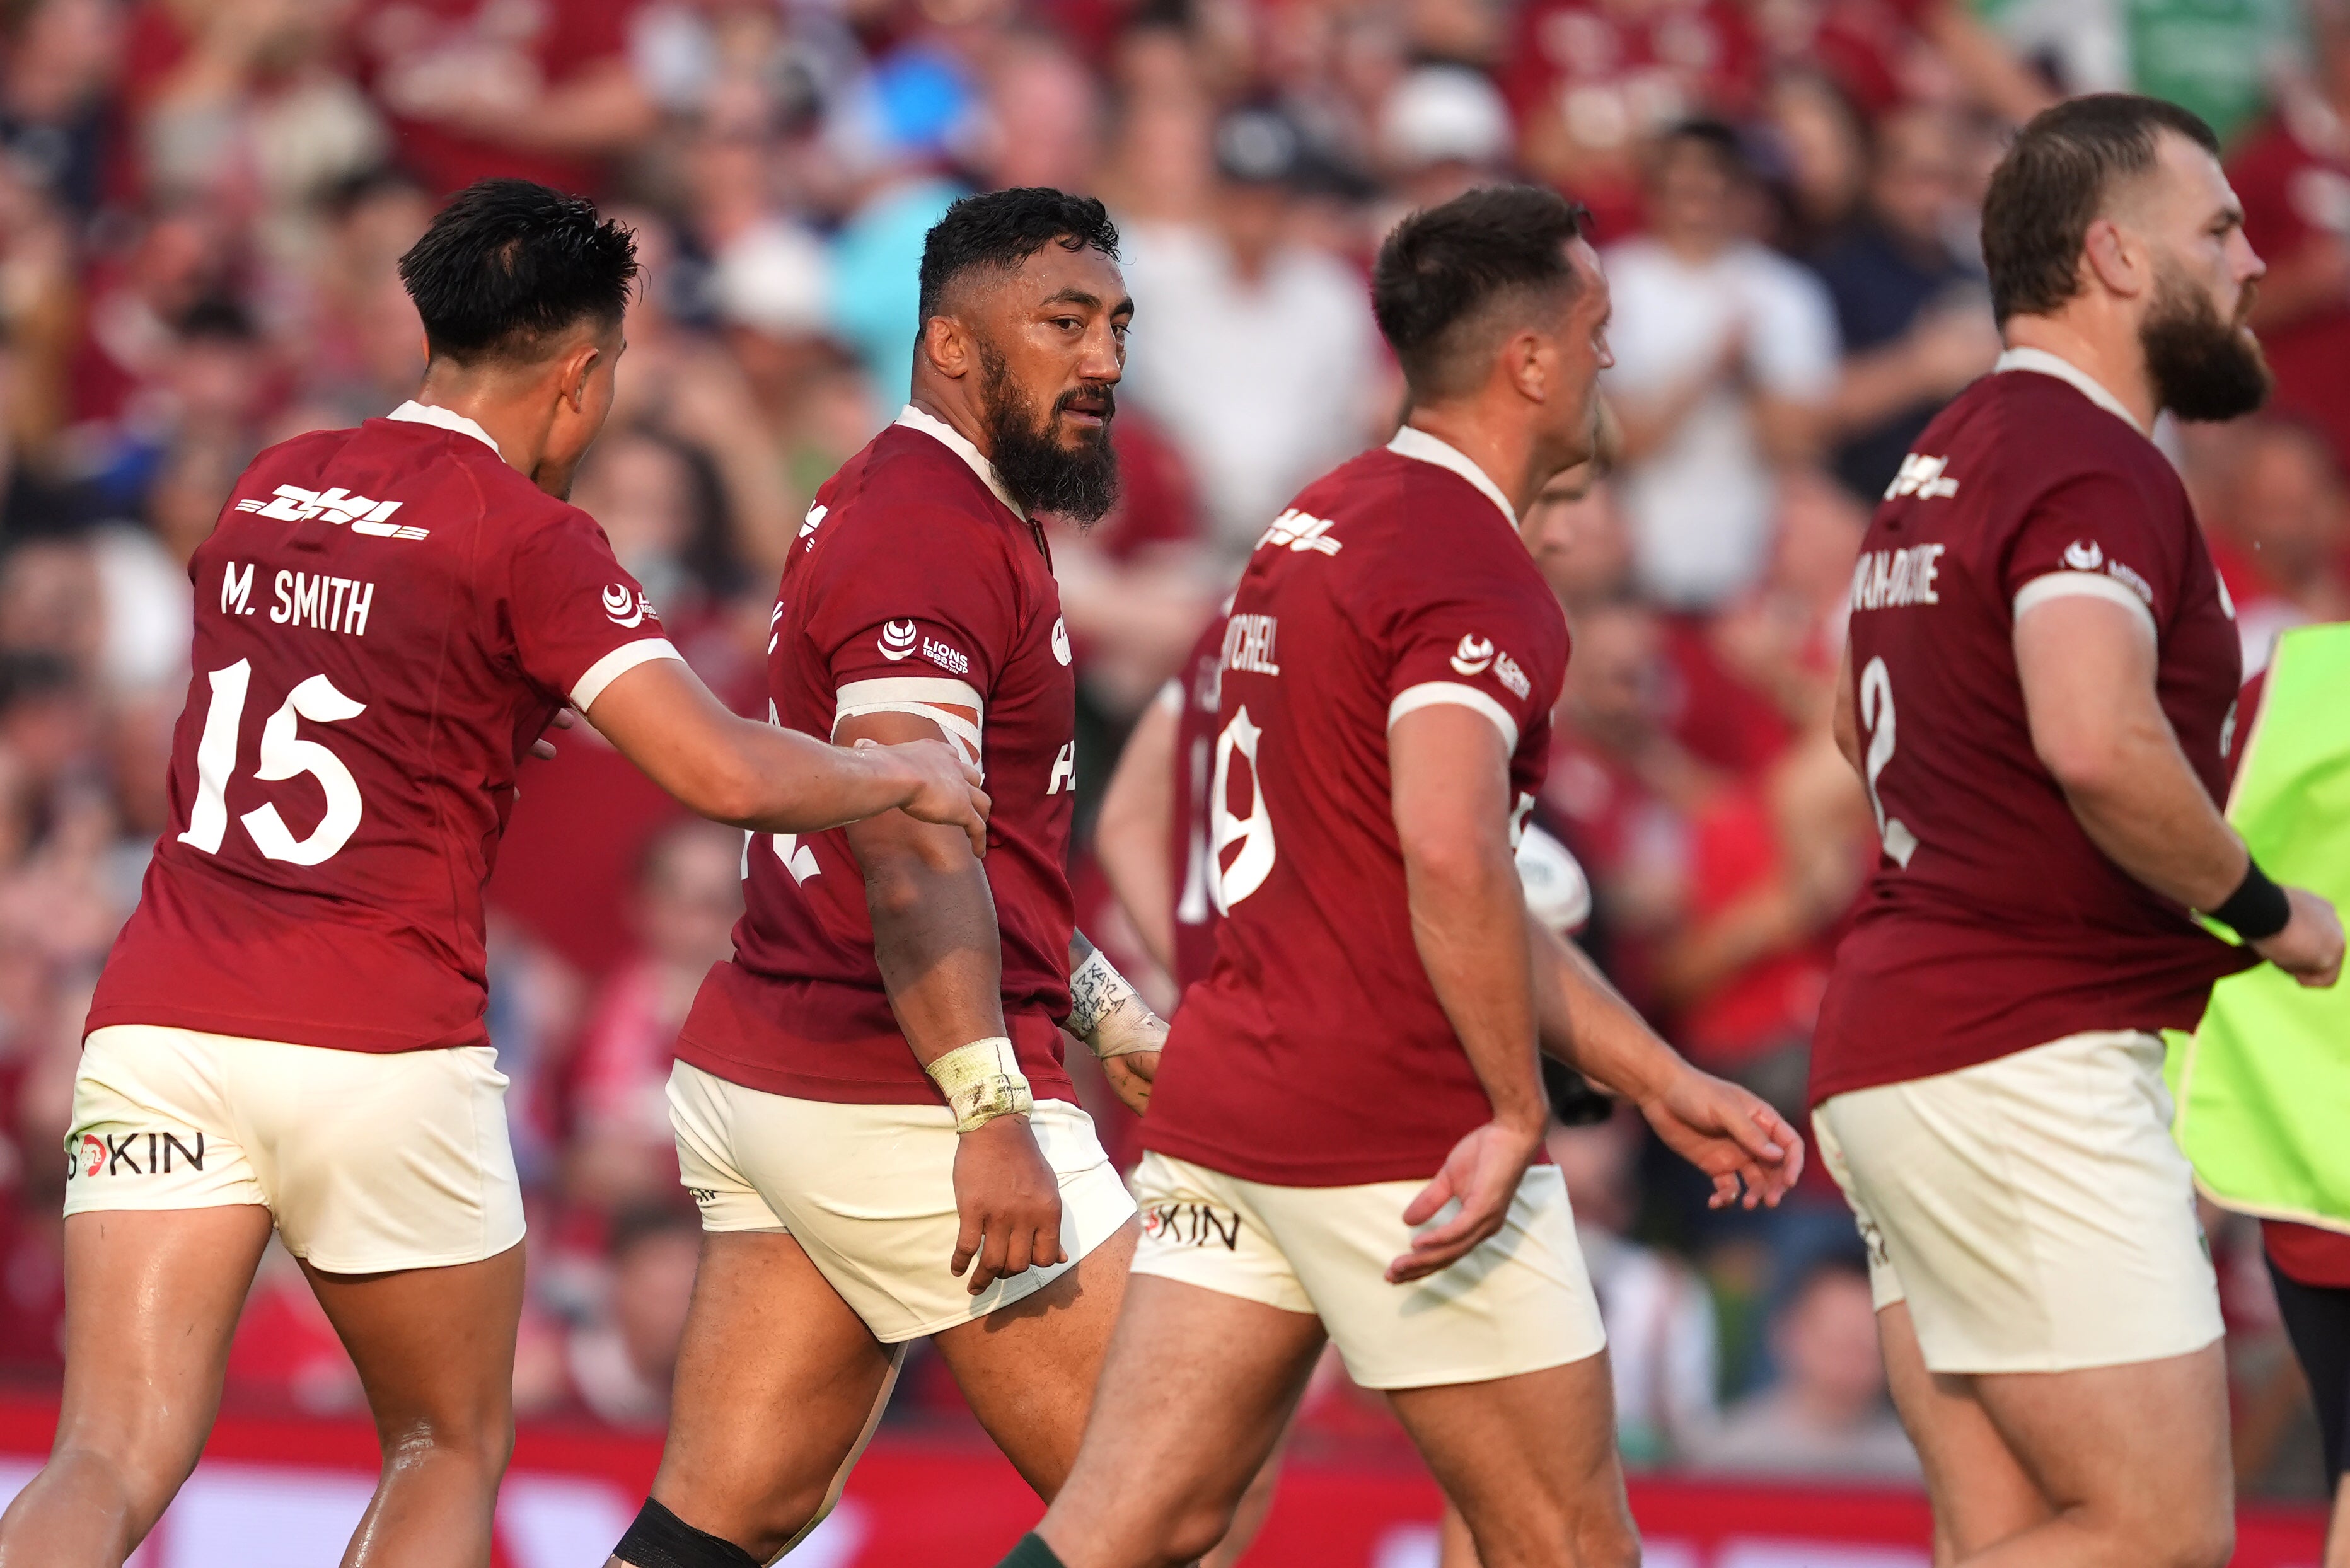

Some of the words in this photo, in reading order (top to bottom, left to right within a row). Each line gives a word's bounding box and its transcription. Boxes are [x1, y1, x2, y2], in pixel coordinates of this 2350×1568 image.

[252, 483, 405, 538] DHL
[220, 560, 256, 616] M.
[269, 569, 374, 637] SMITH
[922, 647, 947, 664] 1888
[949, 660, 968, 674] CUP
[923, 637, 968, 668] LIONS
[177, 657, 368, 867] 15
[1860, 655, 1918, 870] 2
